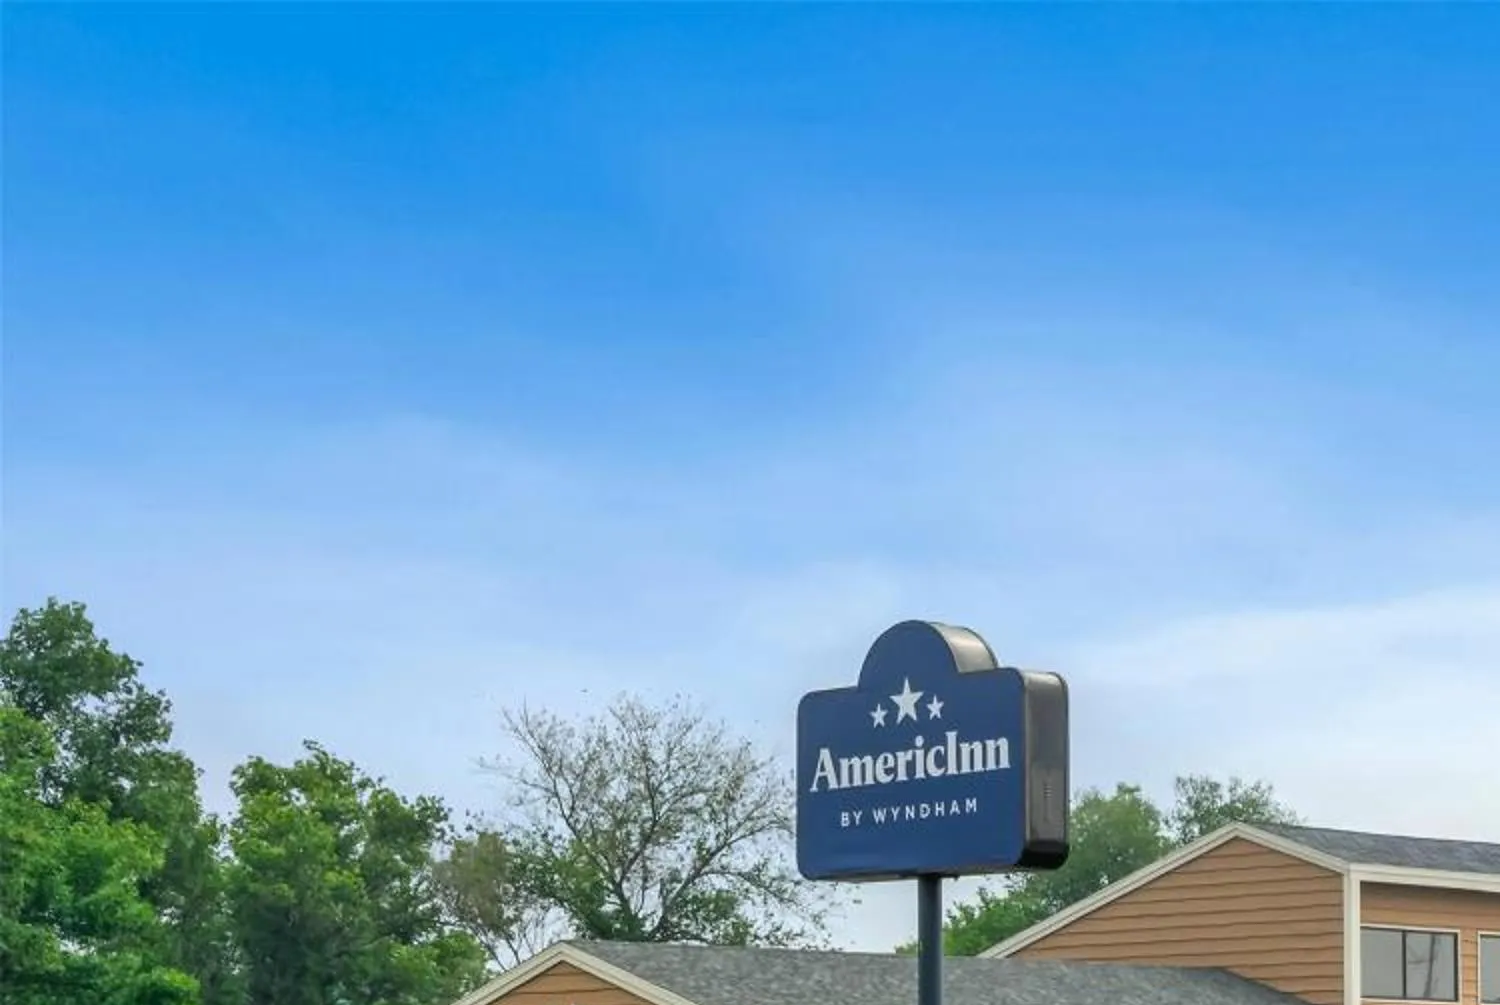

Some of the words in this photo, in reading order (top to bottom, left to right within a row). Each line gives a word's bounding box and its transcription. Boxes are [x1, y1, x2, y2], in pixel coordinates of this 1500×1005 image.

[809, 731, 1011, 792] AmericInn
[840, 810, 864, 828] BY
[872, 797, 978, 825] WYNDHAM
